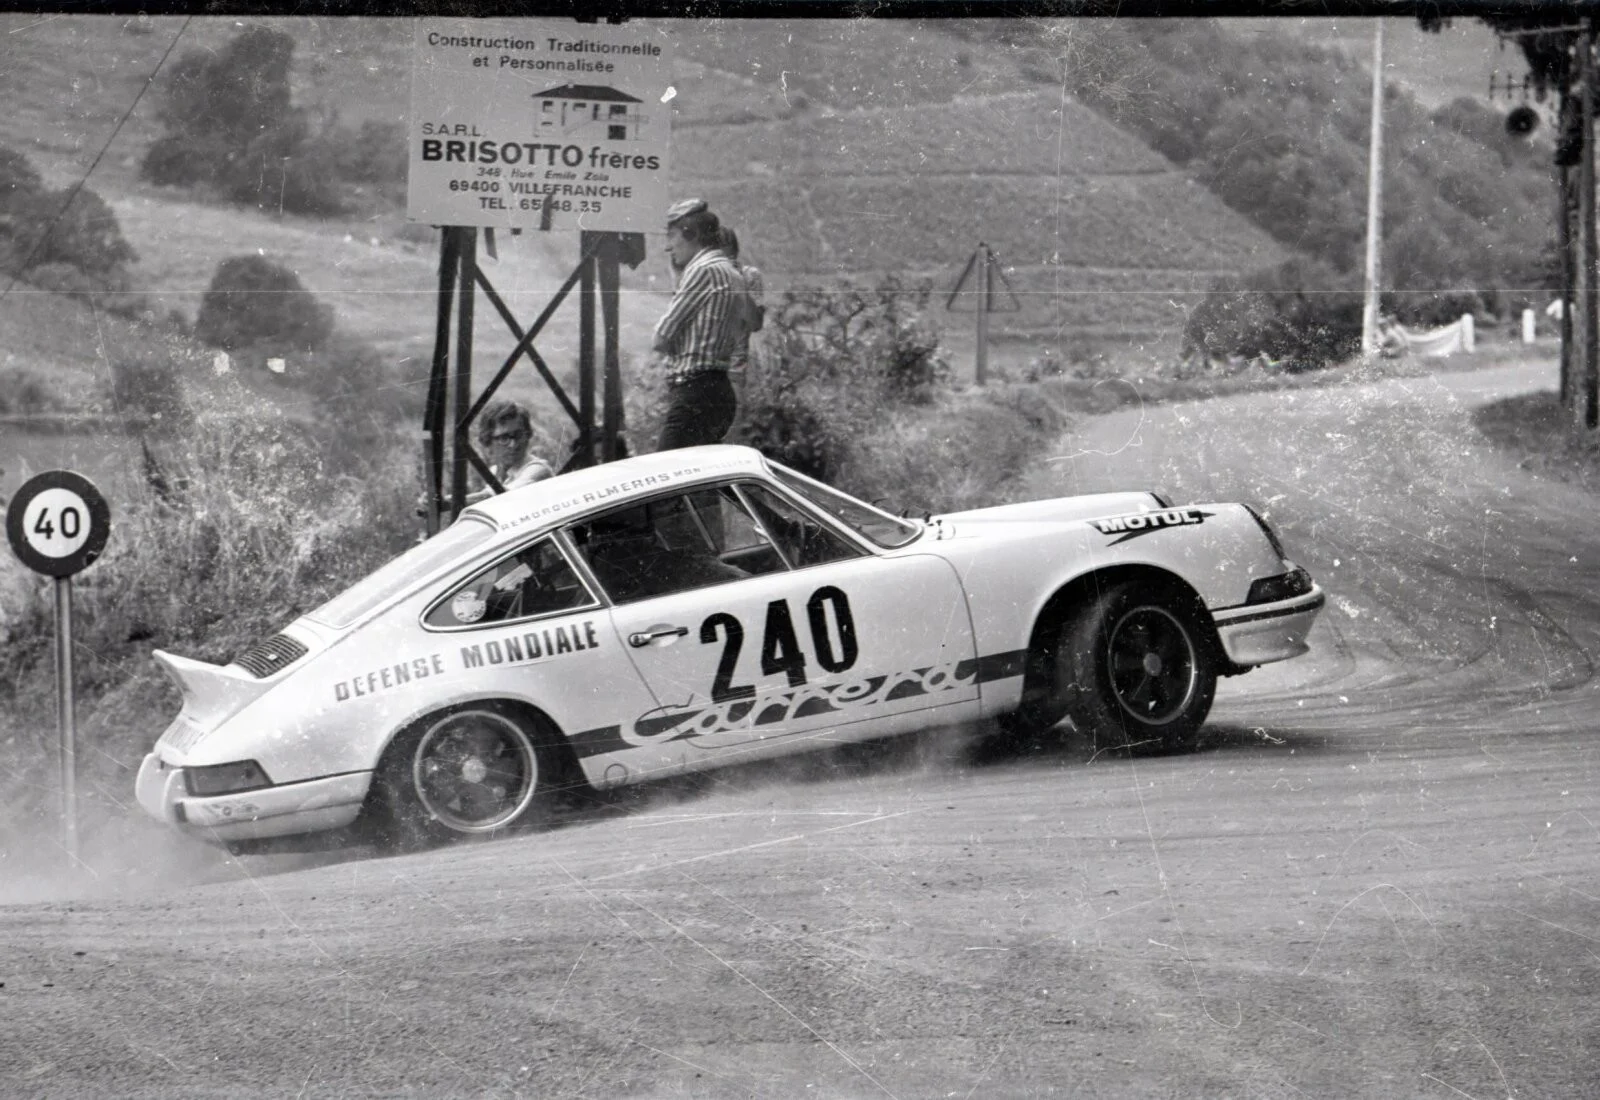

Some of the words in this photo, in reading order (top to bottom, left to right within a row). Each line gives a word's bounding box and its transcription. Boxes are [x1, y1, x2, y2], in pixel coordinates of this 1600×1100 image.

[428, 32, 535, 51] Construction
[547, 37, 662, 57] Traditionnelle
[472, 55, 489, 67] et
[499, 55, 614, 73] Personnalisée
[422, 139, 583, 167] BRISOTTO
[588, 146, 660, 170] frères
[449, 180, 500, 193] 69400
[509, 182, 632, 199] VILLEFRANCHE
[34, 507, 80, 540] 40
[1097, 510, 1200, 533] MOTUL
[700, 585, 858, 703] 240
[334, 653, 444, 702] DEFENSE
[459, 620, 599, 669] MONDIALE
[619, 661, 978, 747] Carrera
